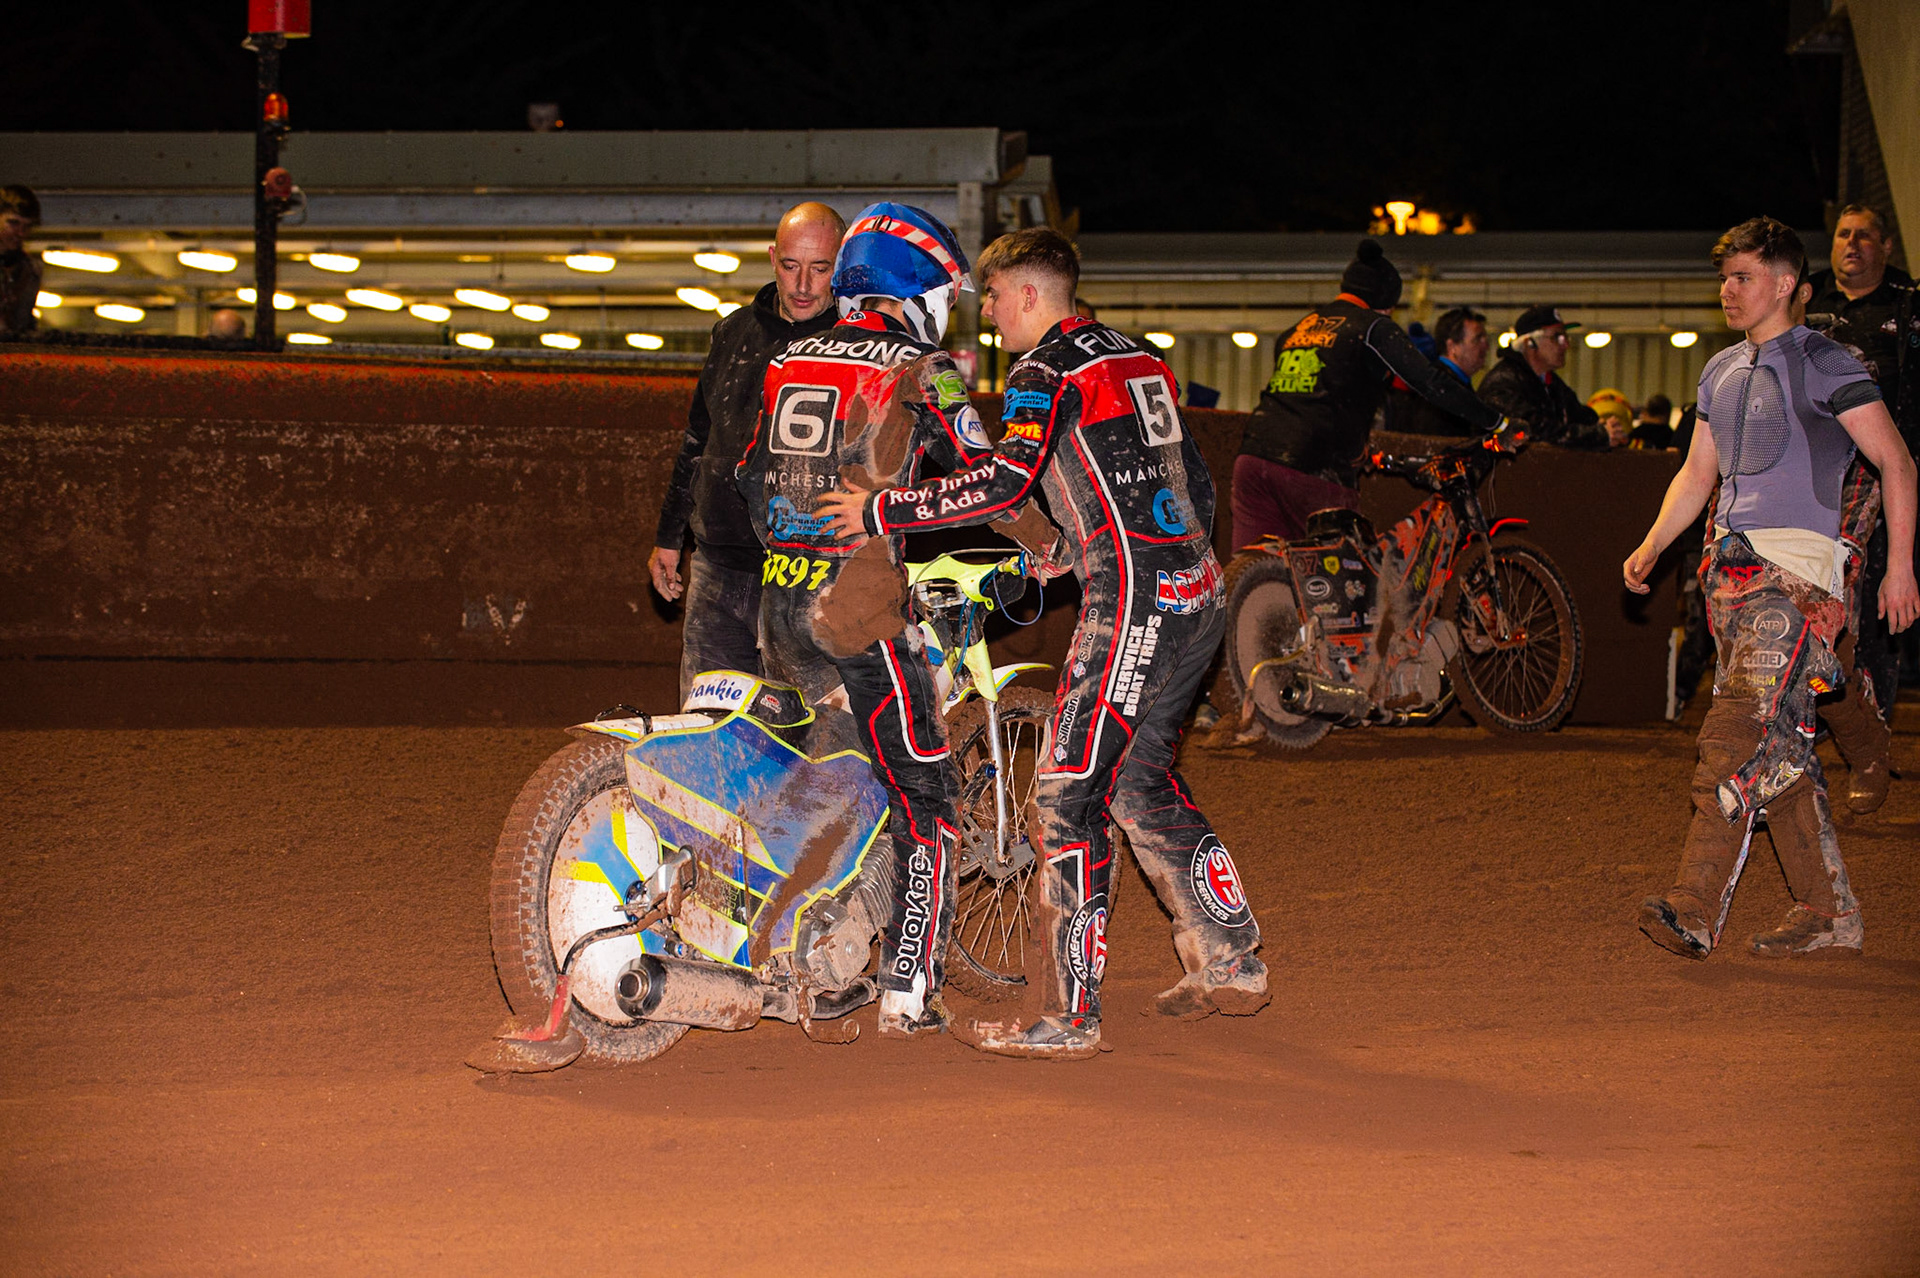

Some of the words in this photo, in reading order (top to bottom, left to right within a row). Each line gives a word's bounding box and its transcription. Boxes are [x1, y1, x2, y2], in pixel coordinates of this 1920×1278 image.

[778, 391, 830, 449] 6
[1141, 381, 1172, 439] 5
[889, 487, 933, 504] Roy,
[938, 464, 995, 493] Jinny
[915, 505, 935, 520] &
[941, 490, 986, 515] Ada
[1113, 624, 1145, 704] BERWICK
[1123, 671, 1146, 717] BOAT
[1138, 614, 1163, 666] TRIPS
[1195, 851, 1206, 878] TYRE
[1211, 851, 1244, 906] STS
[1196, 880, 1230, 921] SERVICES
[1069, 910, 1088, 980] STAKEFORD
